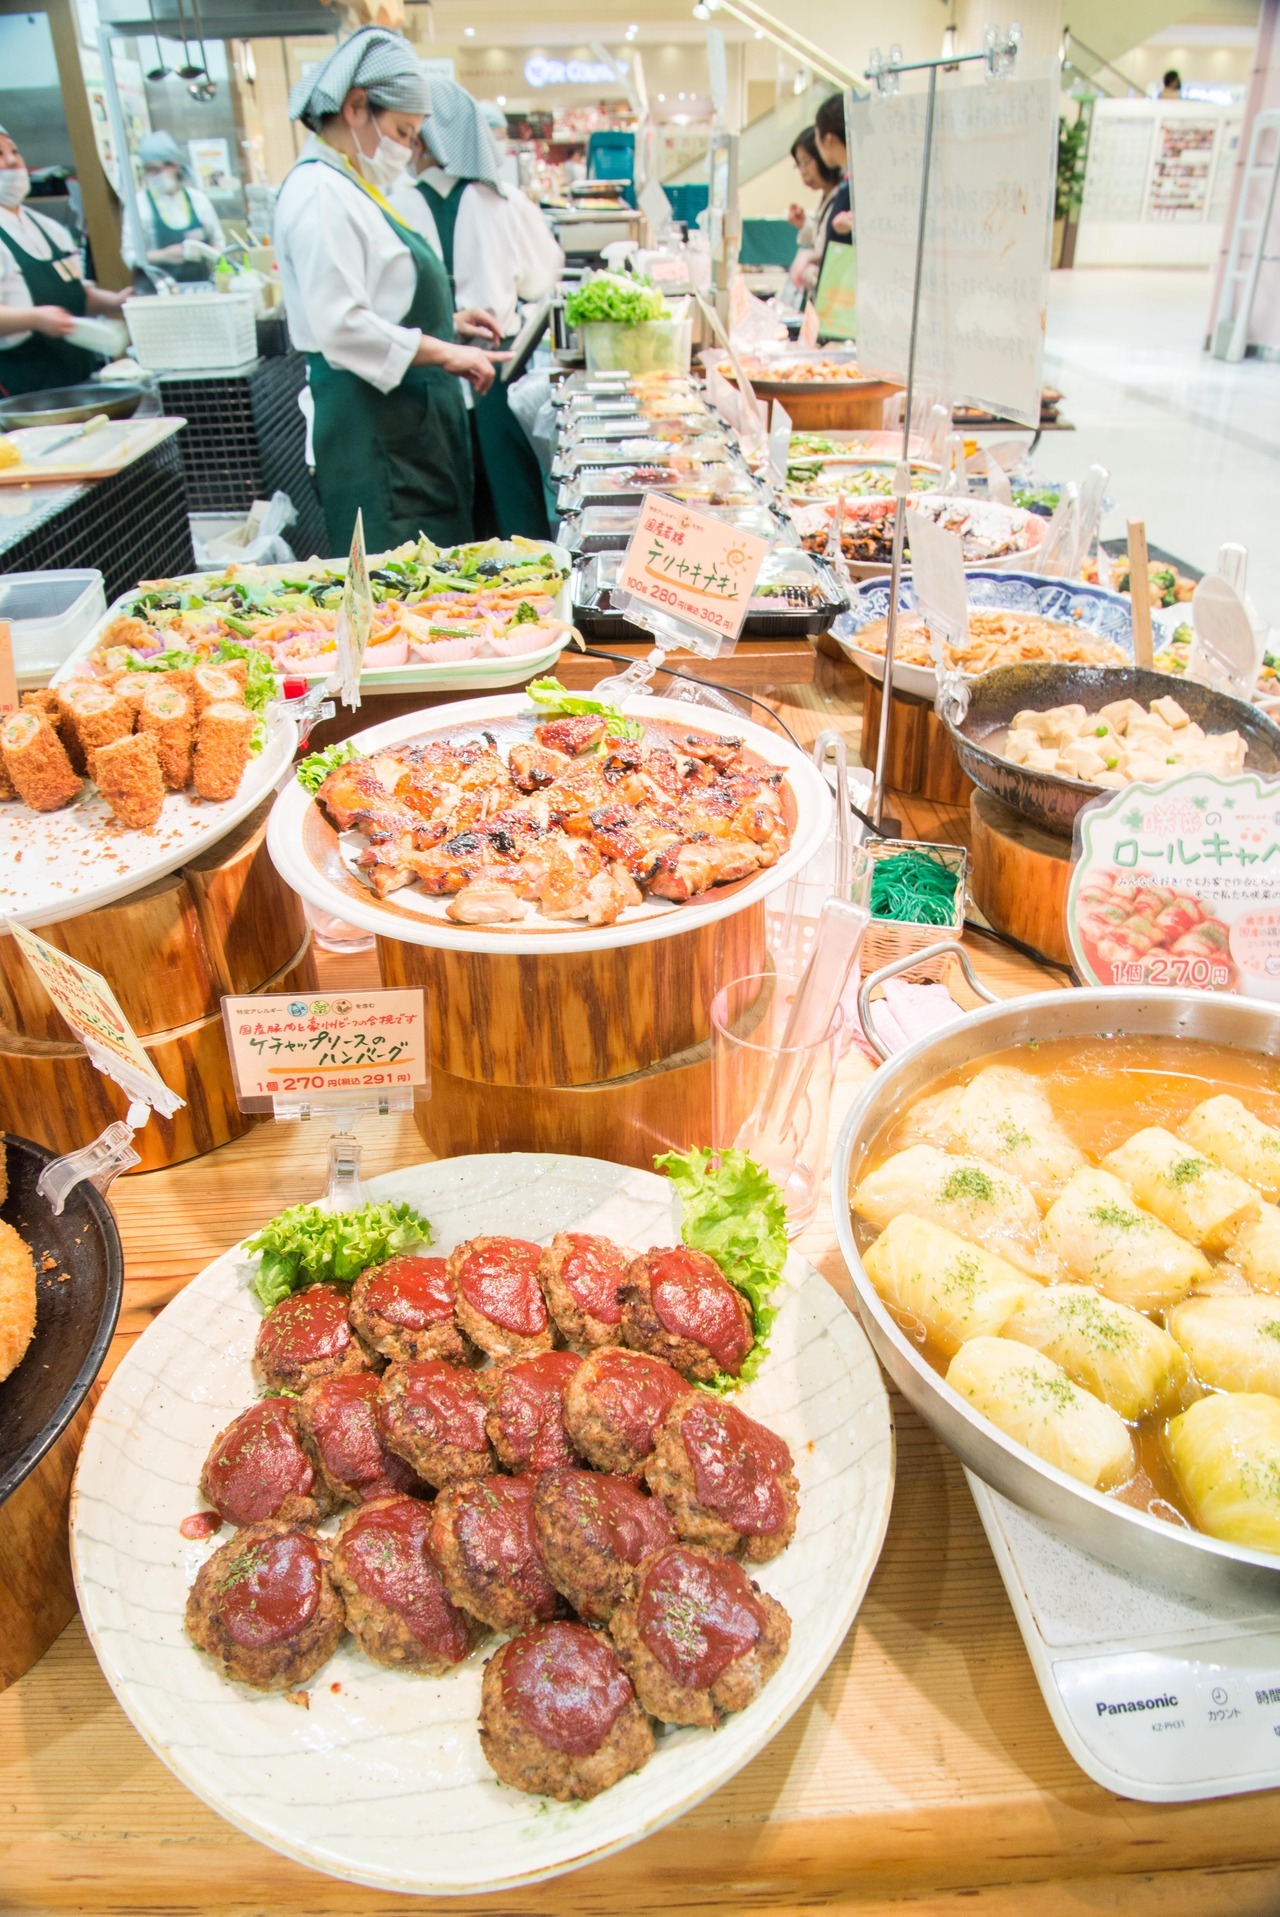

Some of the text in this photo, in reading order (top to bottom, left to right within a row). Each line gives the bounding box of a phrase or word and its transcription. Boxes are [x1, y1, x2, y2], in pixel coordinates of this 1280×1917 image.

[647, 538, 740, 598] テリヤキチキン
[236, 1008, 283, 1016] 特定アレルギー
[355, 1002, 375, 1010] を含む
[249, 1030, 386, 1055] ケチャップソースの
[318, 1041, 409, 1066] ハンバーグ
[1096, 1693, 1179, 1716] Panasonic
[1207, 1707, 1241, 1722] カウント
[1151, 1720, 1185, 1732] KZ-PH31
